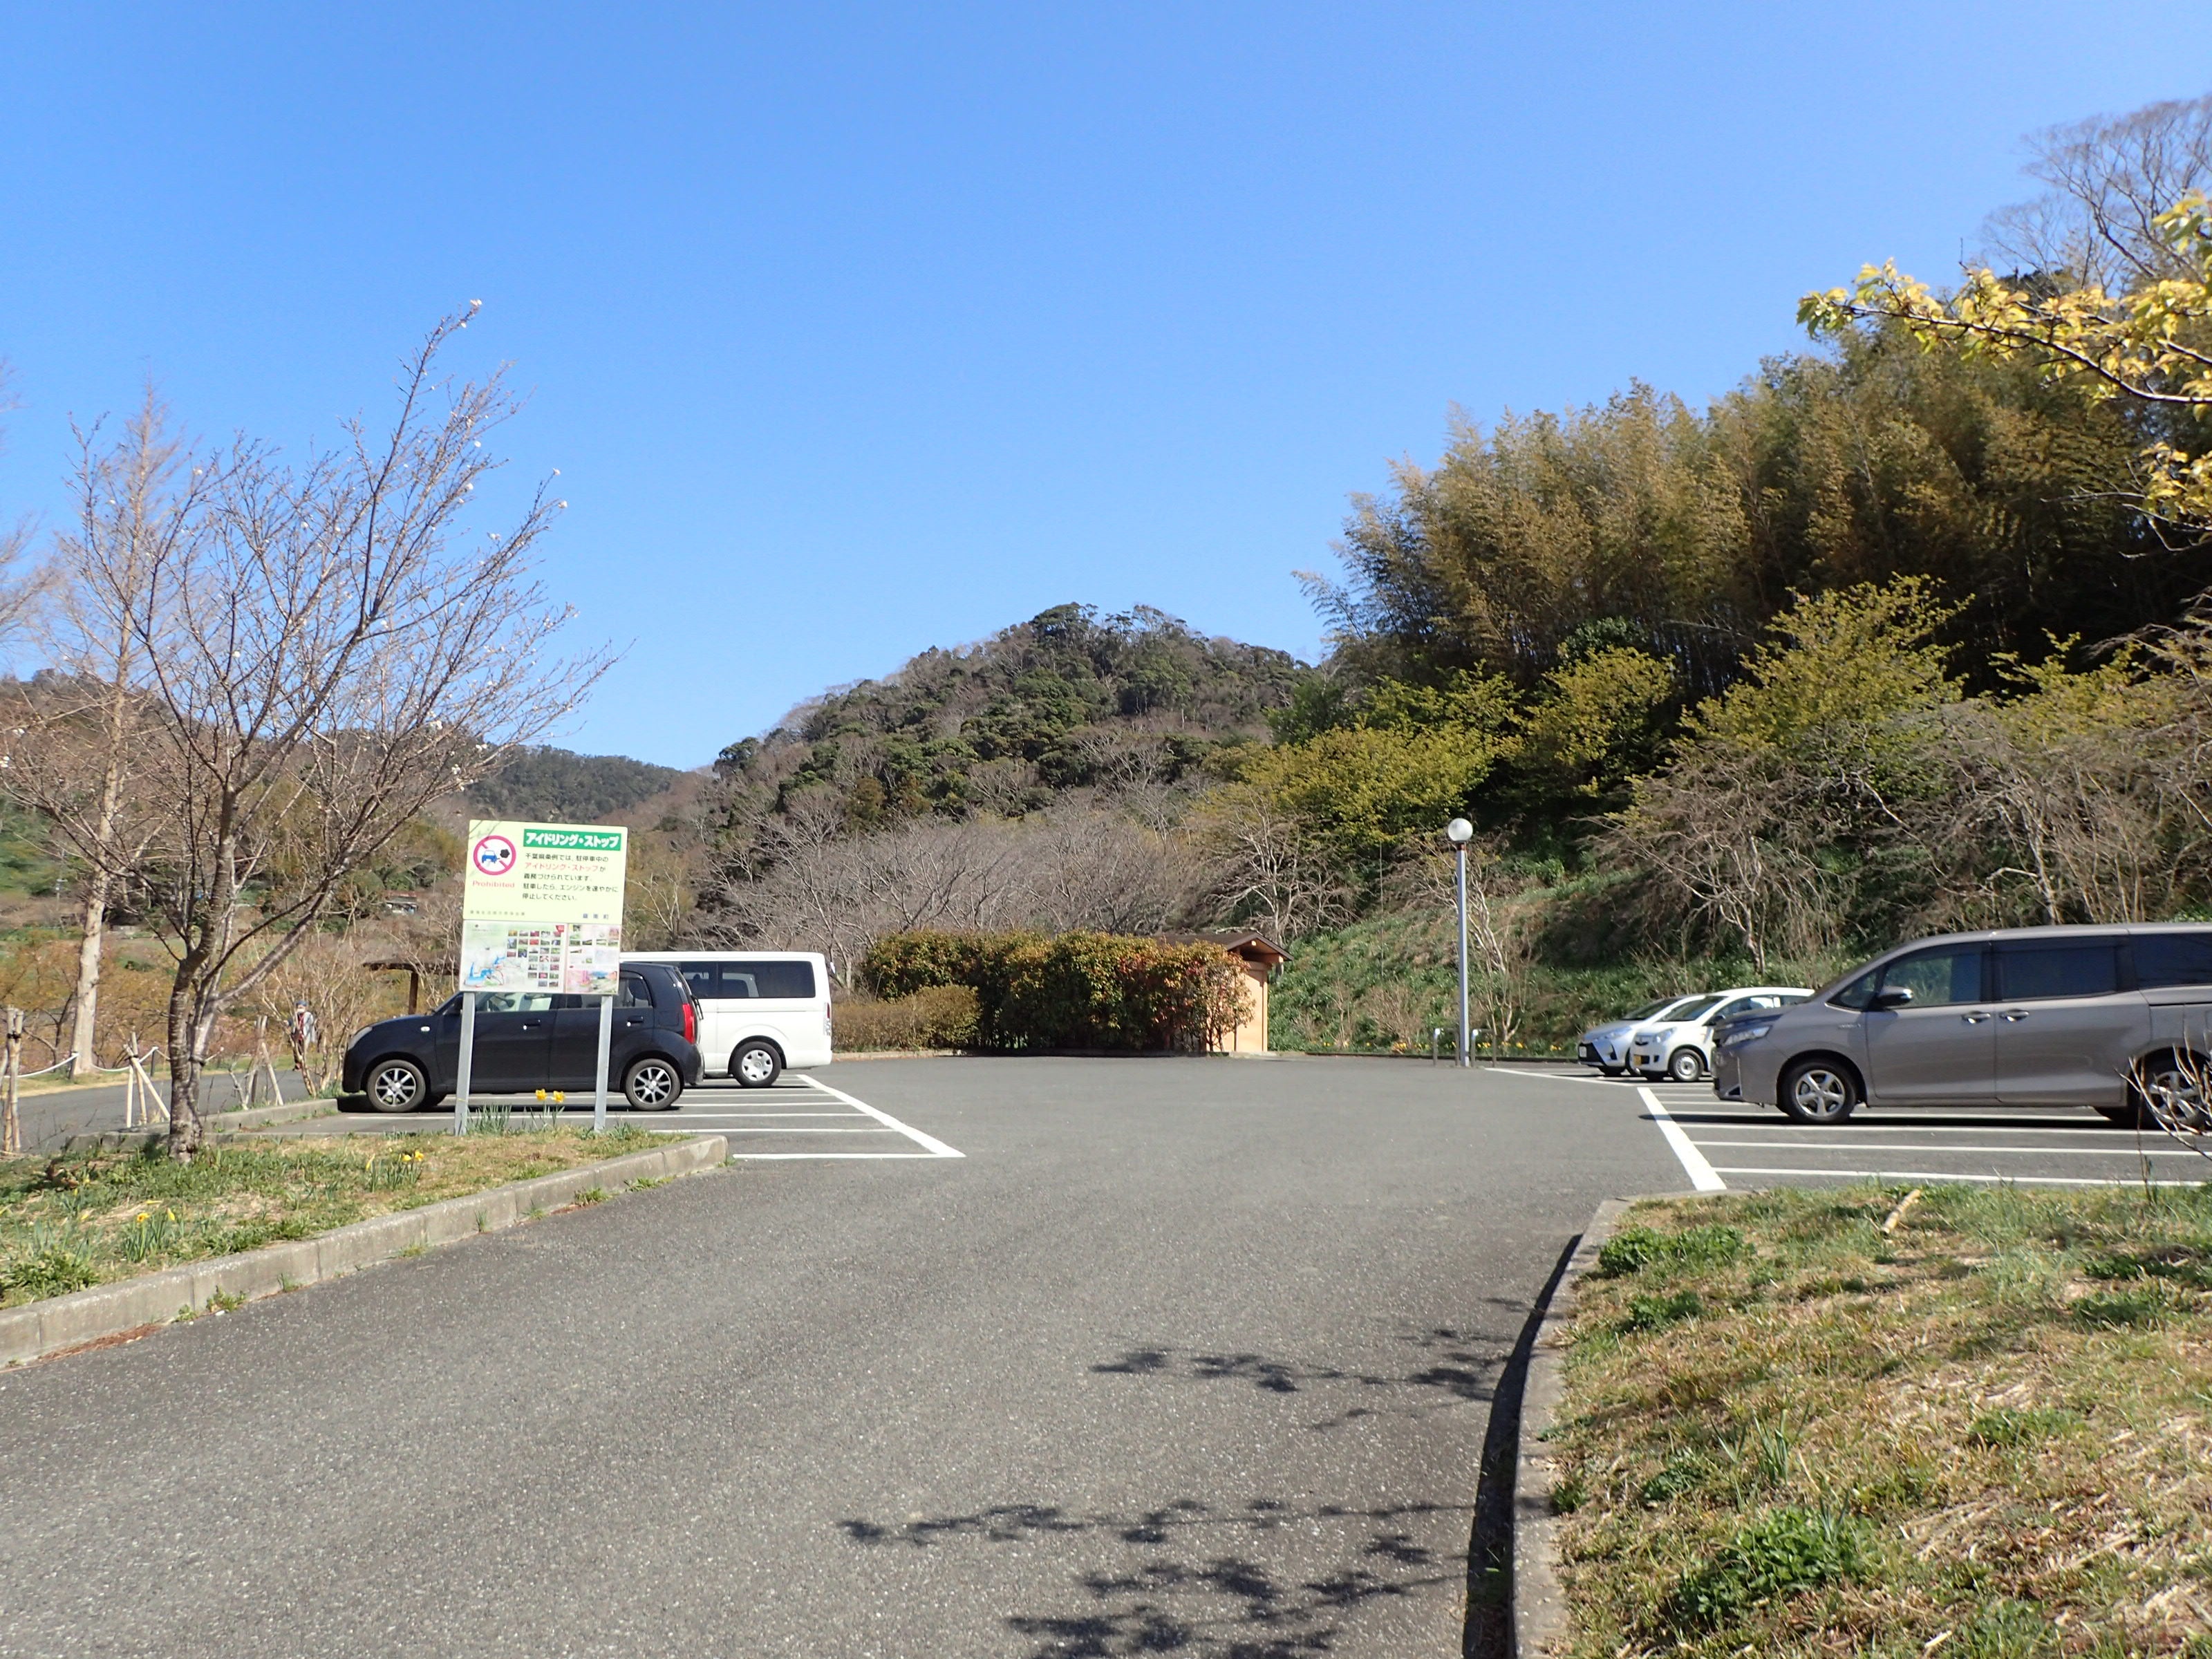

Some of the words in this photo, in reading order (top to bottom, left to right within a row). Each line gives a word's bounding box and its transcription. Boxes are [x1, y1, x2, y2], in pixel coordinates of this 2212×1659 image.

[525, 832, 619, 848] アイドリング・ストップ
[473, 880, 515, 888] Prohibited
